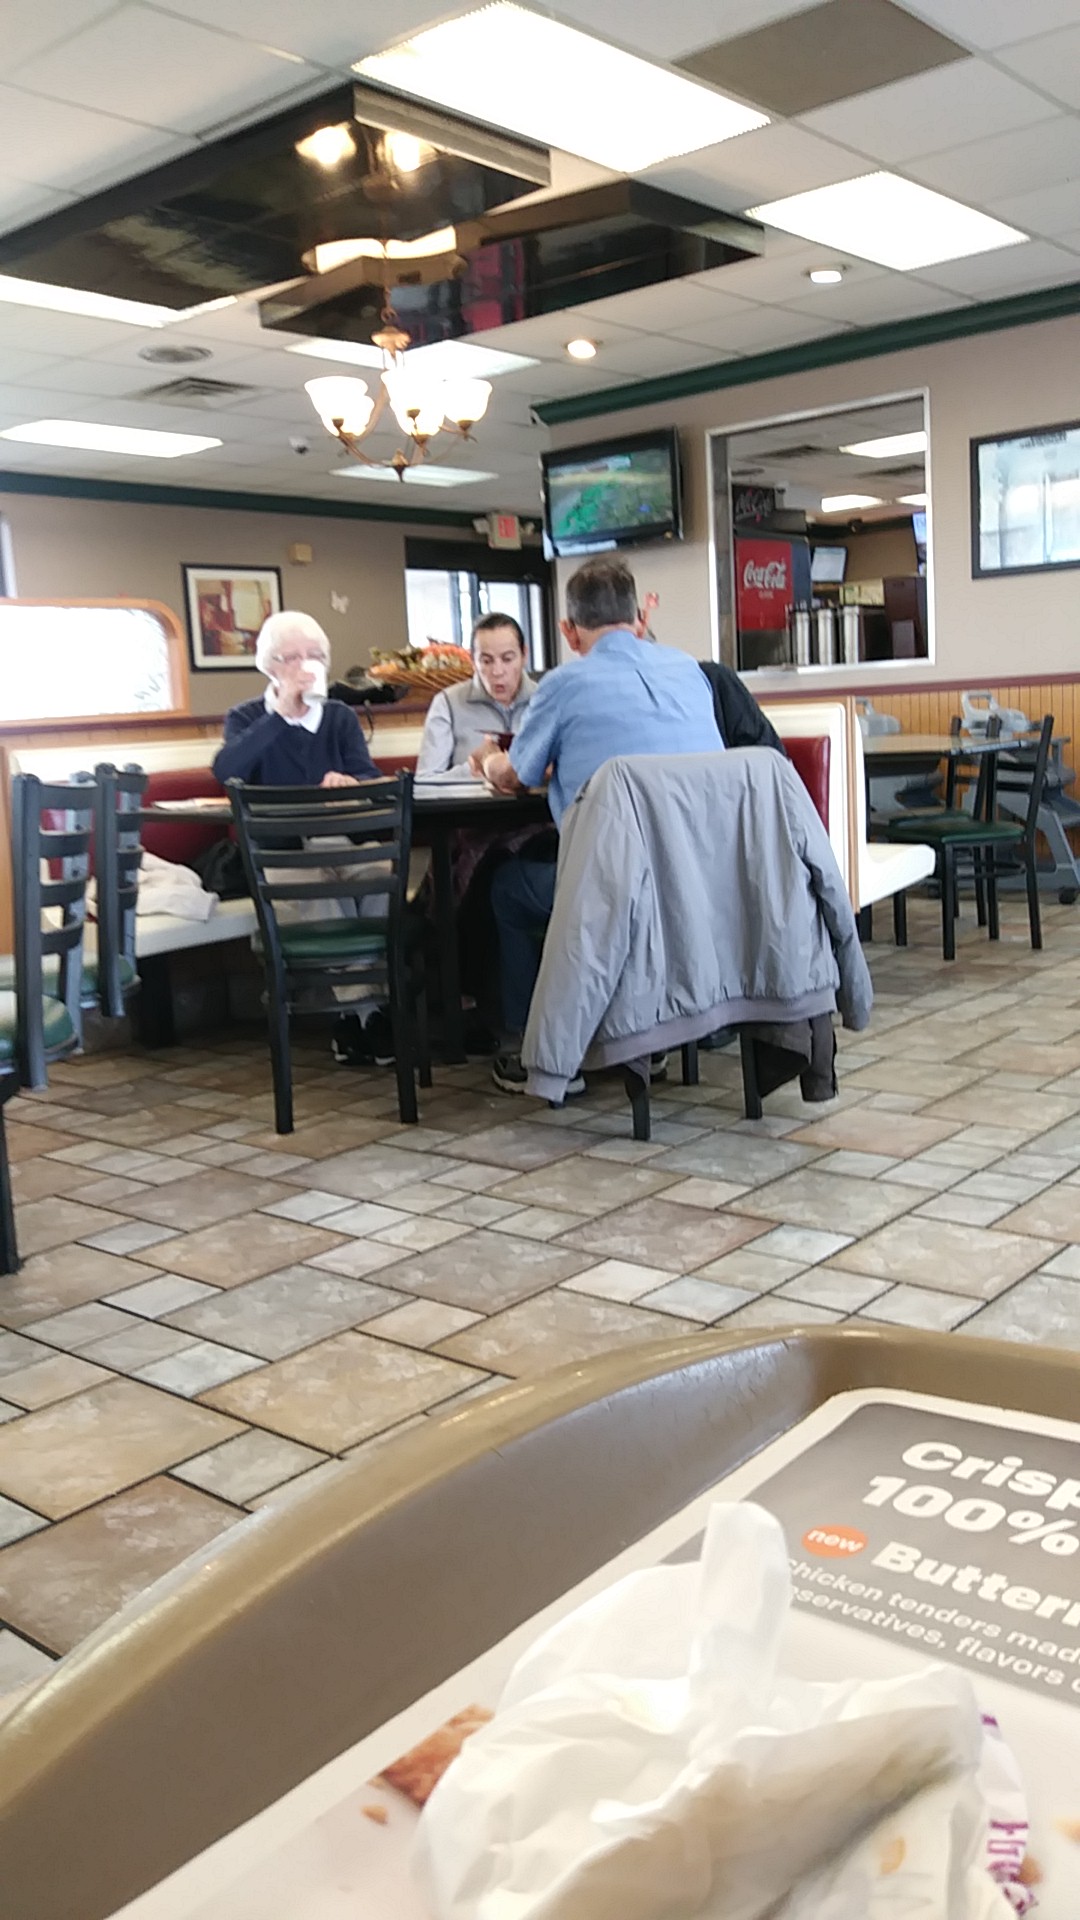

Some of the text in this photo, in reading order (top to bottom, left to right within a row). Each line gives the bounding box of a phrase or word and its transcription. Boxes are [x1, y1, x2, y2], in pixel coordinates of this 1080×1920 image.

[807, 1529, 864, 1552] new
[862, 1475, 1080, 1556] 100%
[888, 1592, 1002, 1638] tenders
[1006, 1631, 1080, 1664] mad
[956, 1636, 1065, 1686] flavors
